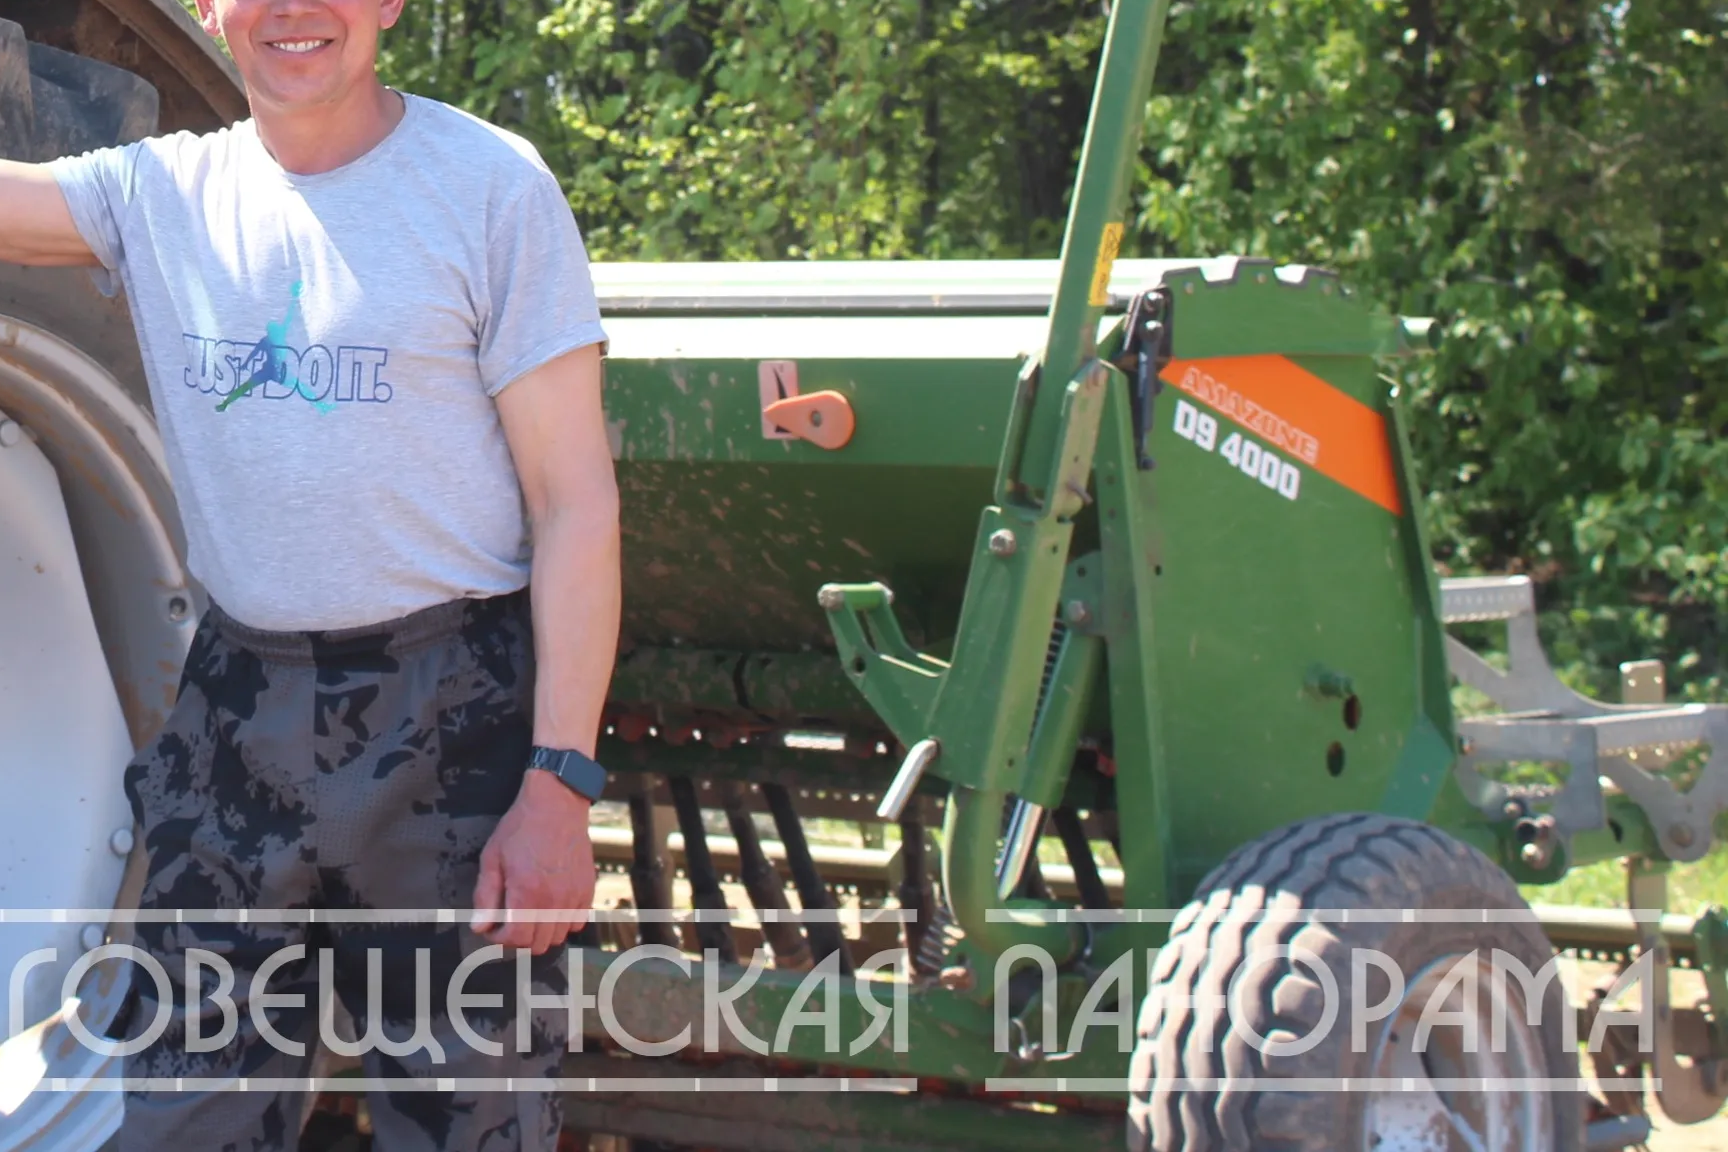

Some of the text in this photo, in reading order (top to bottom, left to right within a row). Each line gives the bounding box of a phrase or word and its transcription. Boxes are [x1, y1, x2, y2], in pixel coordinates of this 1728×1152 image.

[264, 344, 334, 401] DO
[334, 345, 393, 403] IT.
[1179, 365, 1320, 466] AMAZONE
[1173, 398, 1301, 501] D9 4000
